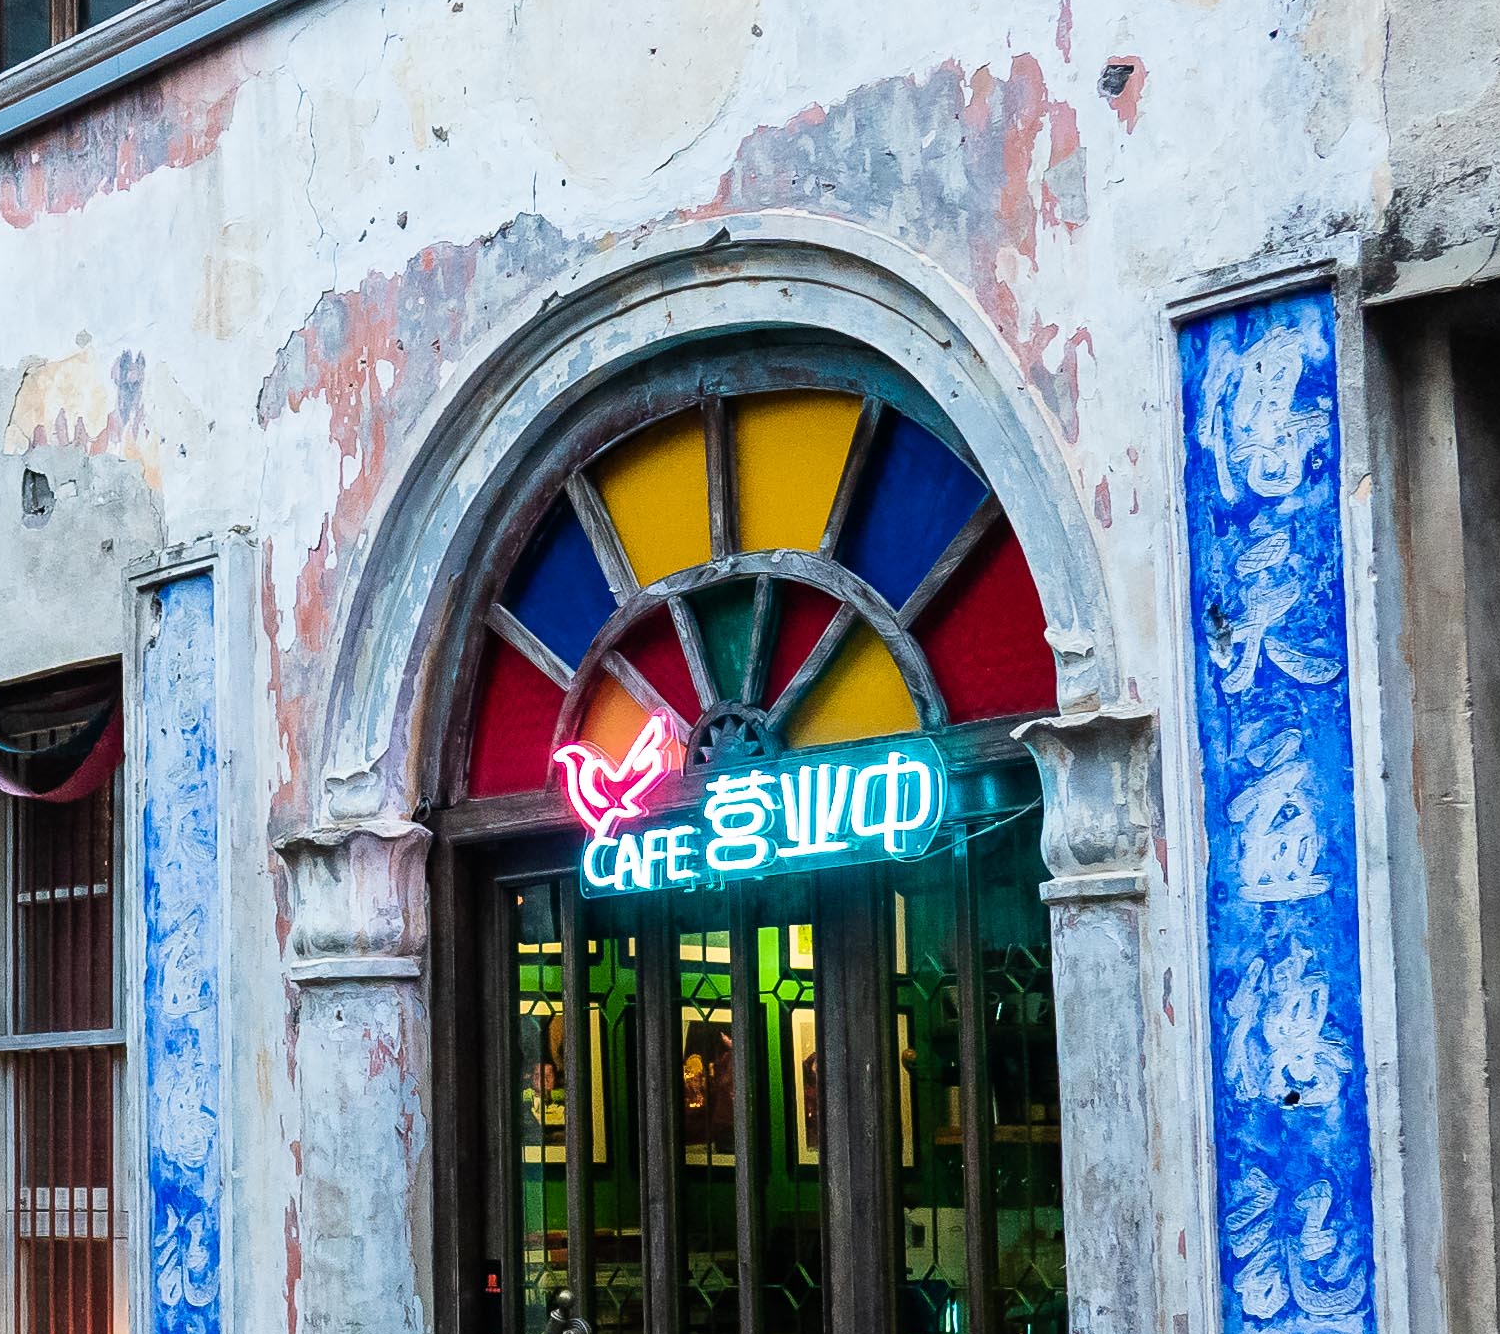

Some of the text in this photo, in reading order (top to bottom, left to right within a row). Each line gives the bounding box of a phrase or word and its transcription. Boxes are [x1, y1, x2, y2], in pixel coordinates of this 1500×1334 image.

[583, 824, 701, 890] CAFE
[705, 751, 940, 872] 营业中
